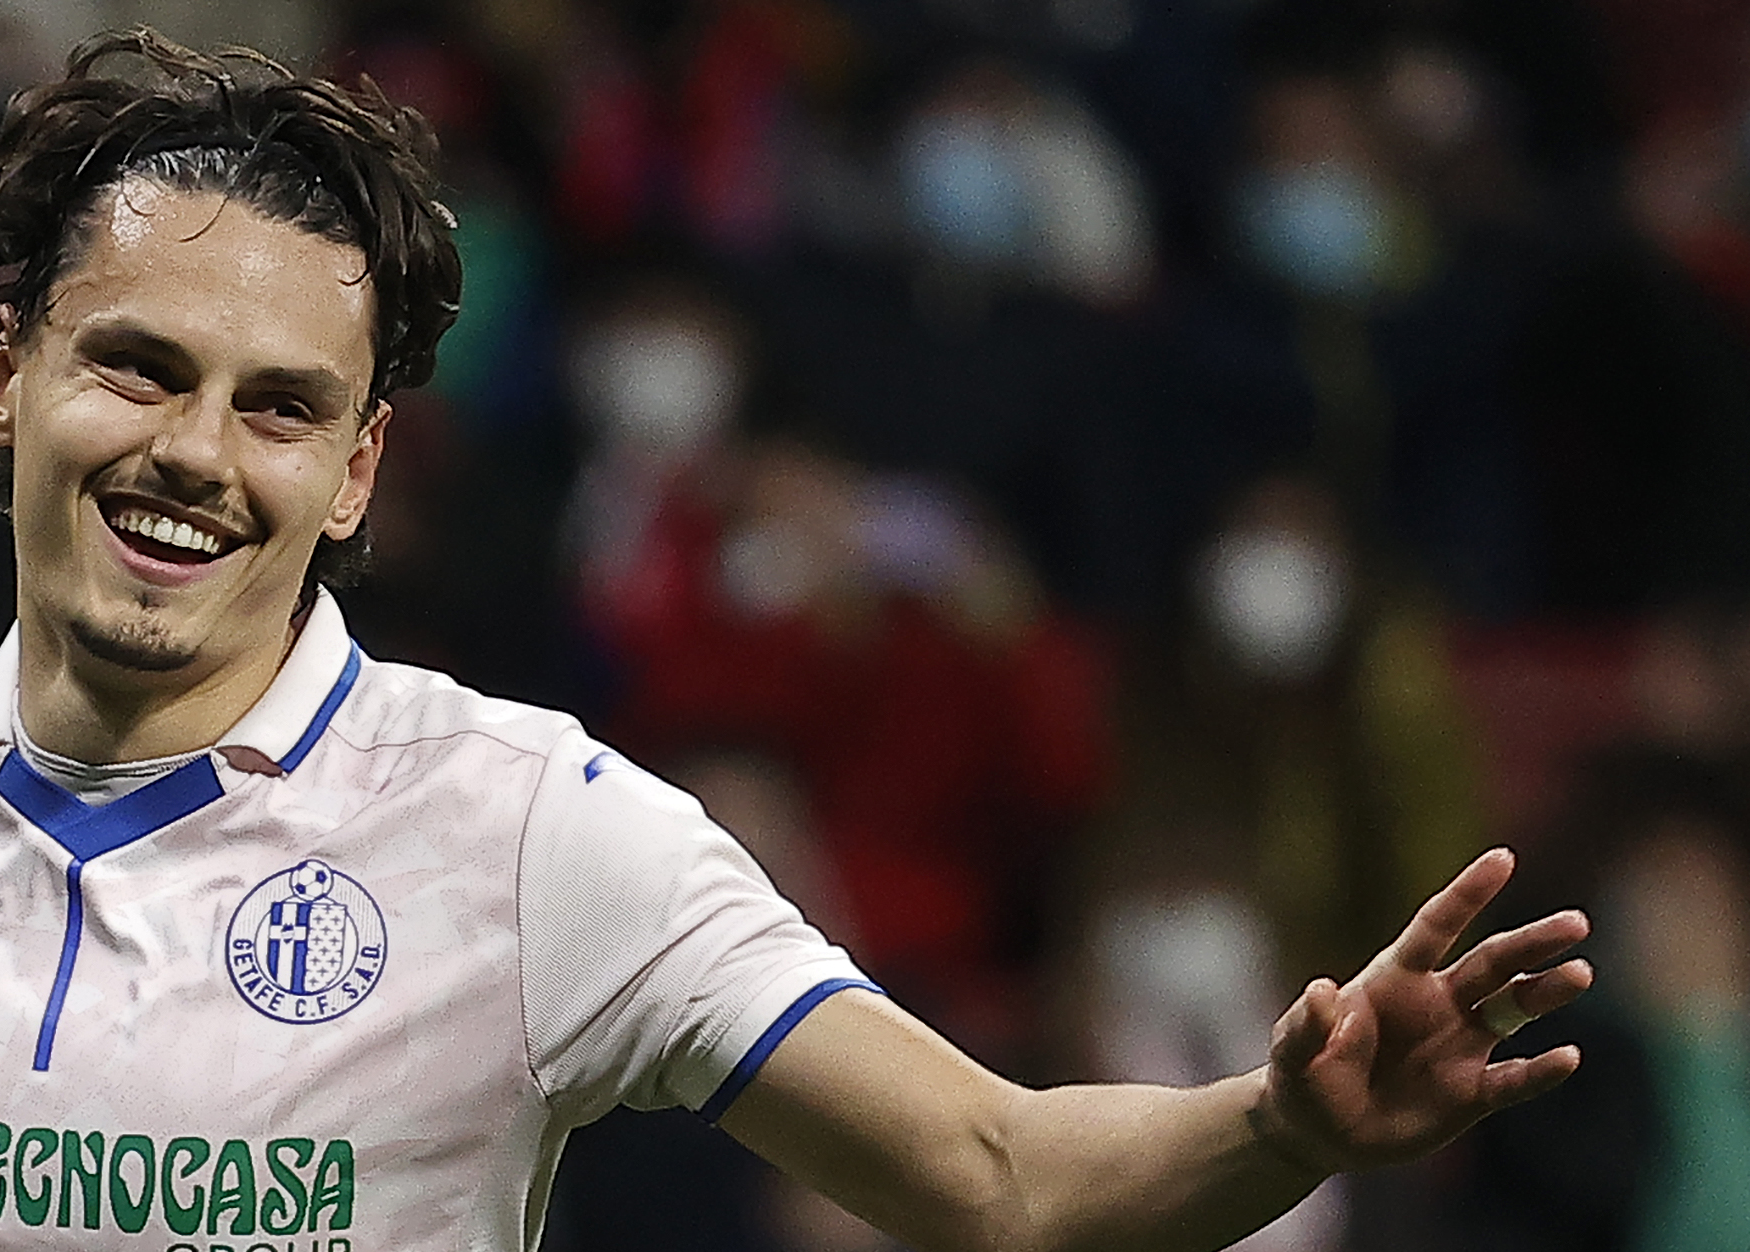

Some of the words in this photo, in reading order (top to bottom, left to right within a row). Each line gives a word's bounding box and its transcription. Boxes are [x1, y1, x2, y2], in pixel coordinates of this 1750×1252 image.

[232, 938, 285, 1012] GETAFE
[295, 995, 337, 1018] C.F.
[342, 943, 382, 1000] S.A.D.
